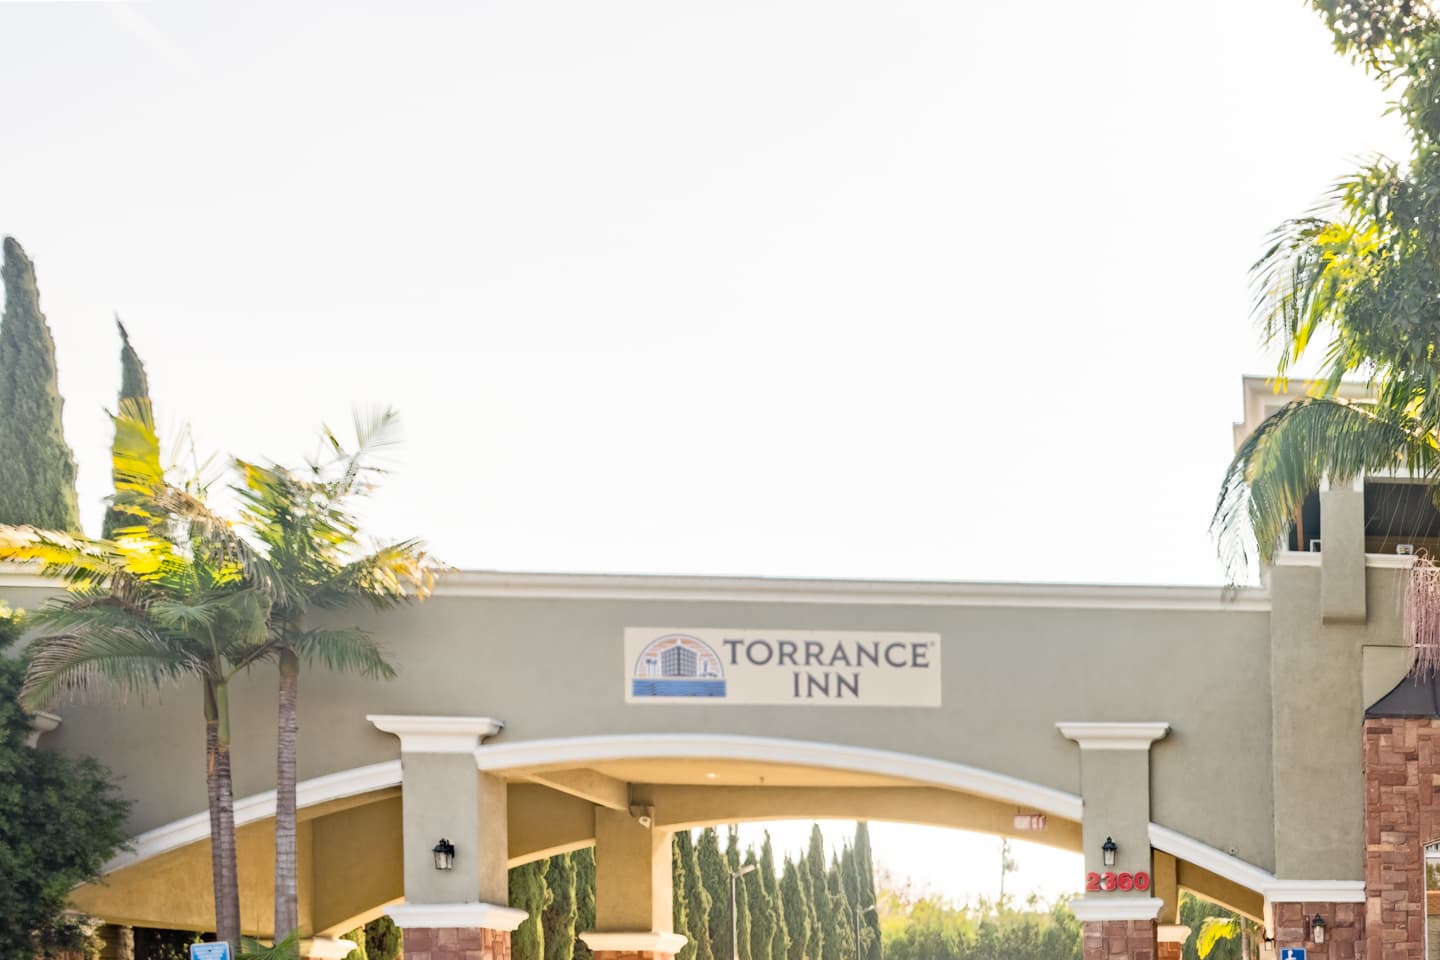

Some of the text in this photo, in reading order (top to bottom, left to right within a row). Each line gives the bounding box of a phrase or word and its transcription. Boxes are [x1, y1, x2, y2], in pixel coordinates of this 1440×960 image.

[722, 638, 930, 668] TORRANCE
[792, 671, 860, 698] INN
[1086, 871, 1150, 892] 2360
